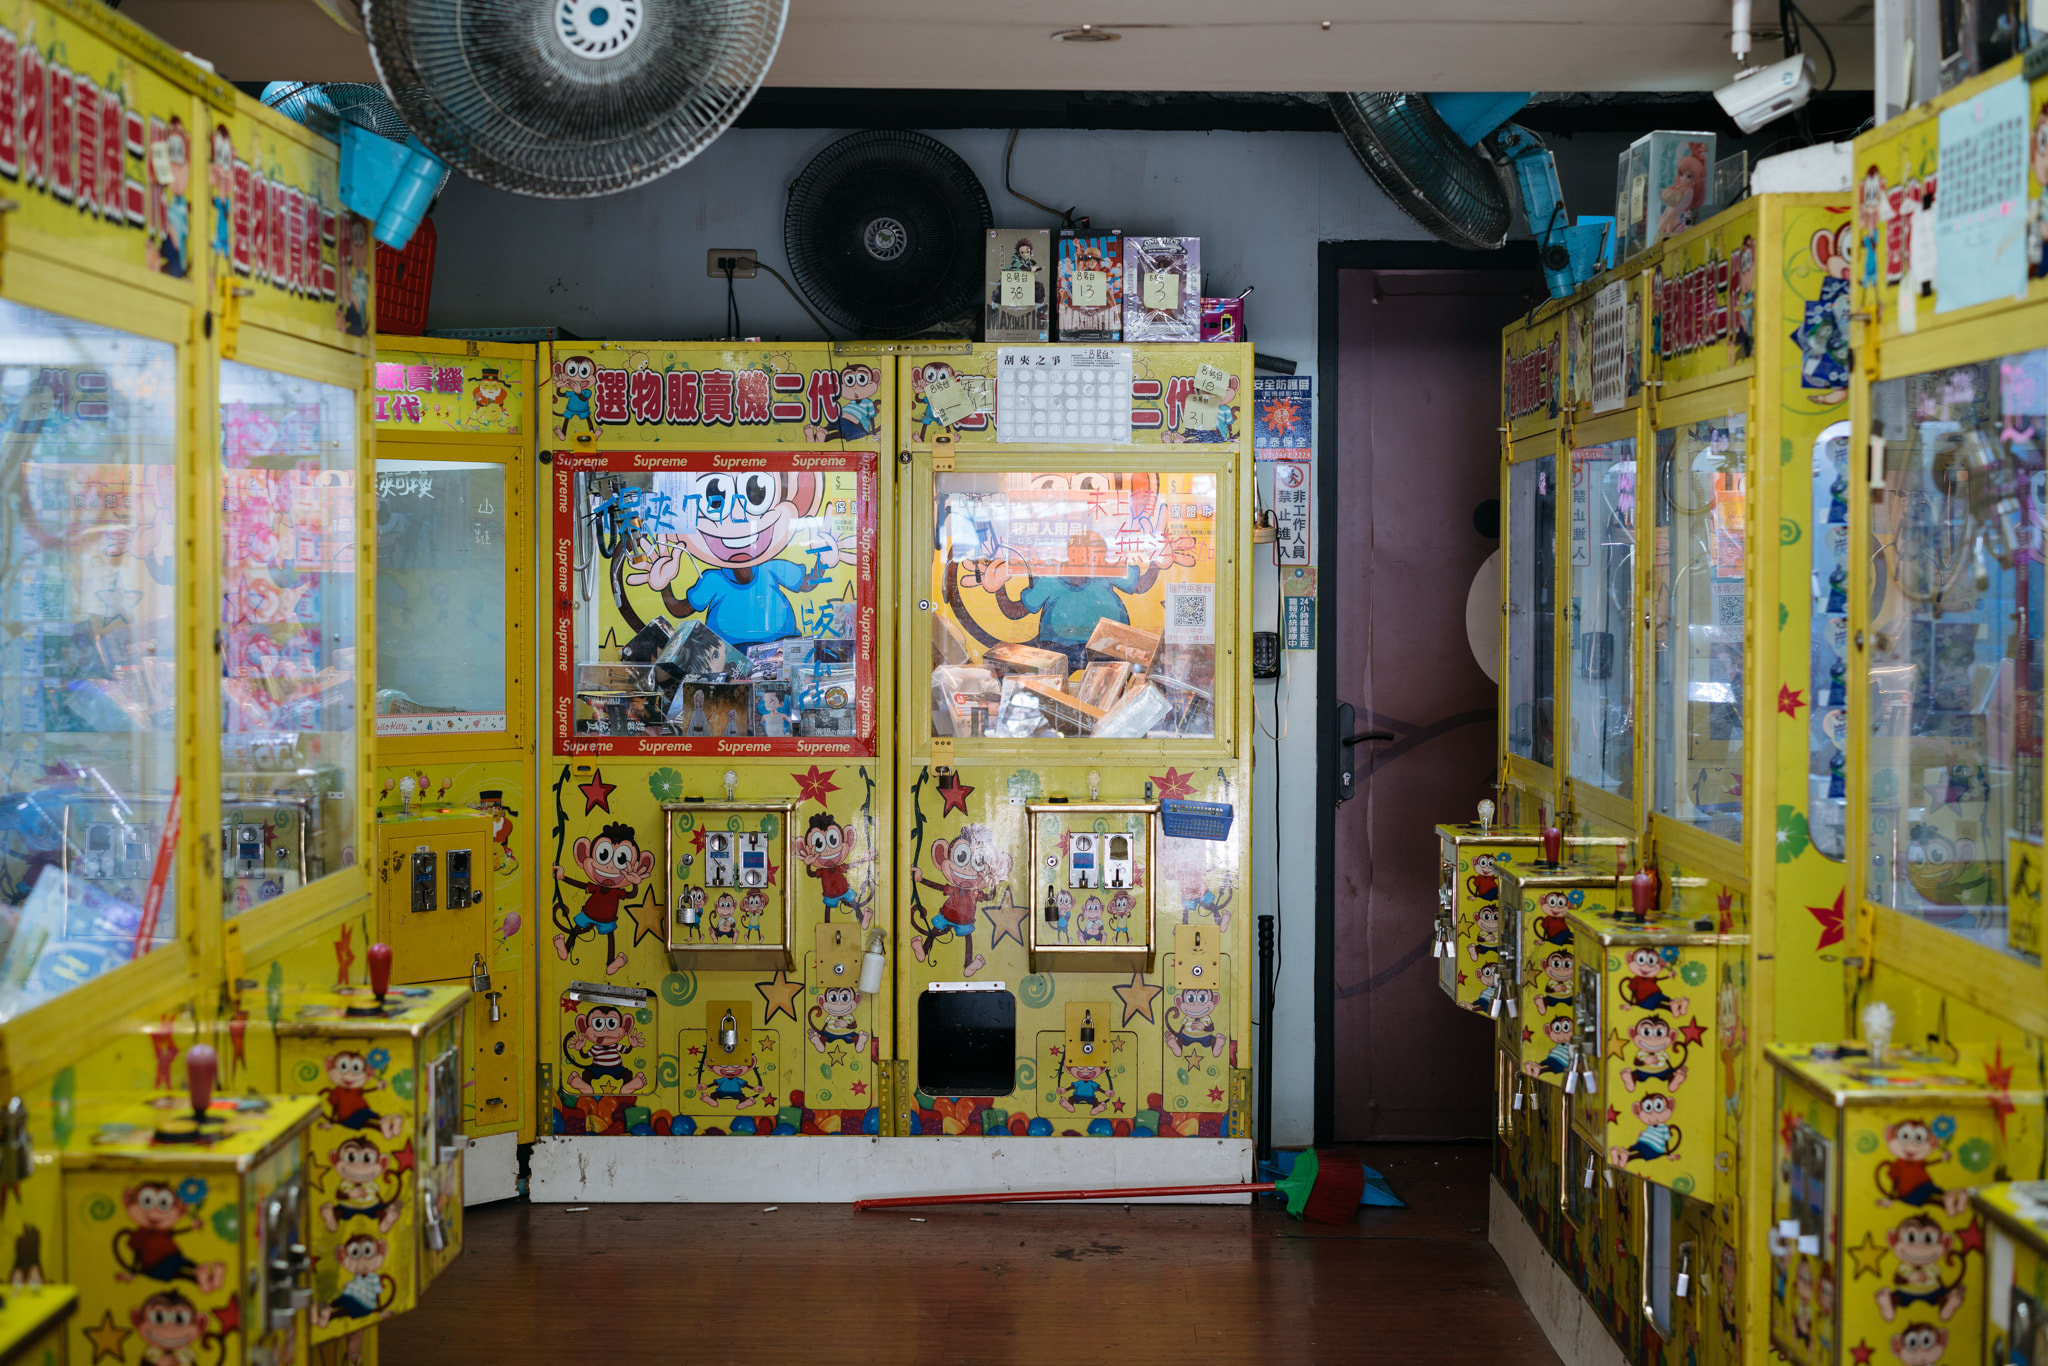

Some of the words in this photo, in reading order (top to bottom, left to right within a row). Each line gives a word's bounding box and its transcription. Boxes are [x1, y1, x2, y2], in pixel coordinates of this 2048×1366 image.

[1080, 285, 1094, 299] 13
[1154, 282, 1165, 302] 3
[595, 369, 842, 425] 選物販賣機二代
[557, 453, 608, 470] Supreme
[633, 454, 688, 470] Supreme
[712, 454, 767, 470] Supreme
[792, 454, 846, 469] Supreme
[859, 455, 870, 502] upreme
[1278, 490, 1291, 559] 禁止進入
[1293, 490, 1306, 559] 非工作人員
[556, 538, 571, 592] Supreme
[859, 527, 873, 580] Supreme
[556, 618, 570, 671] Supreme
[859, 606, 873, 660] Supreme
[859, 685, 873, 739] Supreme
[563, 740, 613, 755] Supreme
[639, 739, 692, 755] Supreme
[717, 740, 771, 755] Supreme
[797, 740, 850, 755] Supreme
